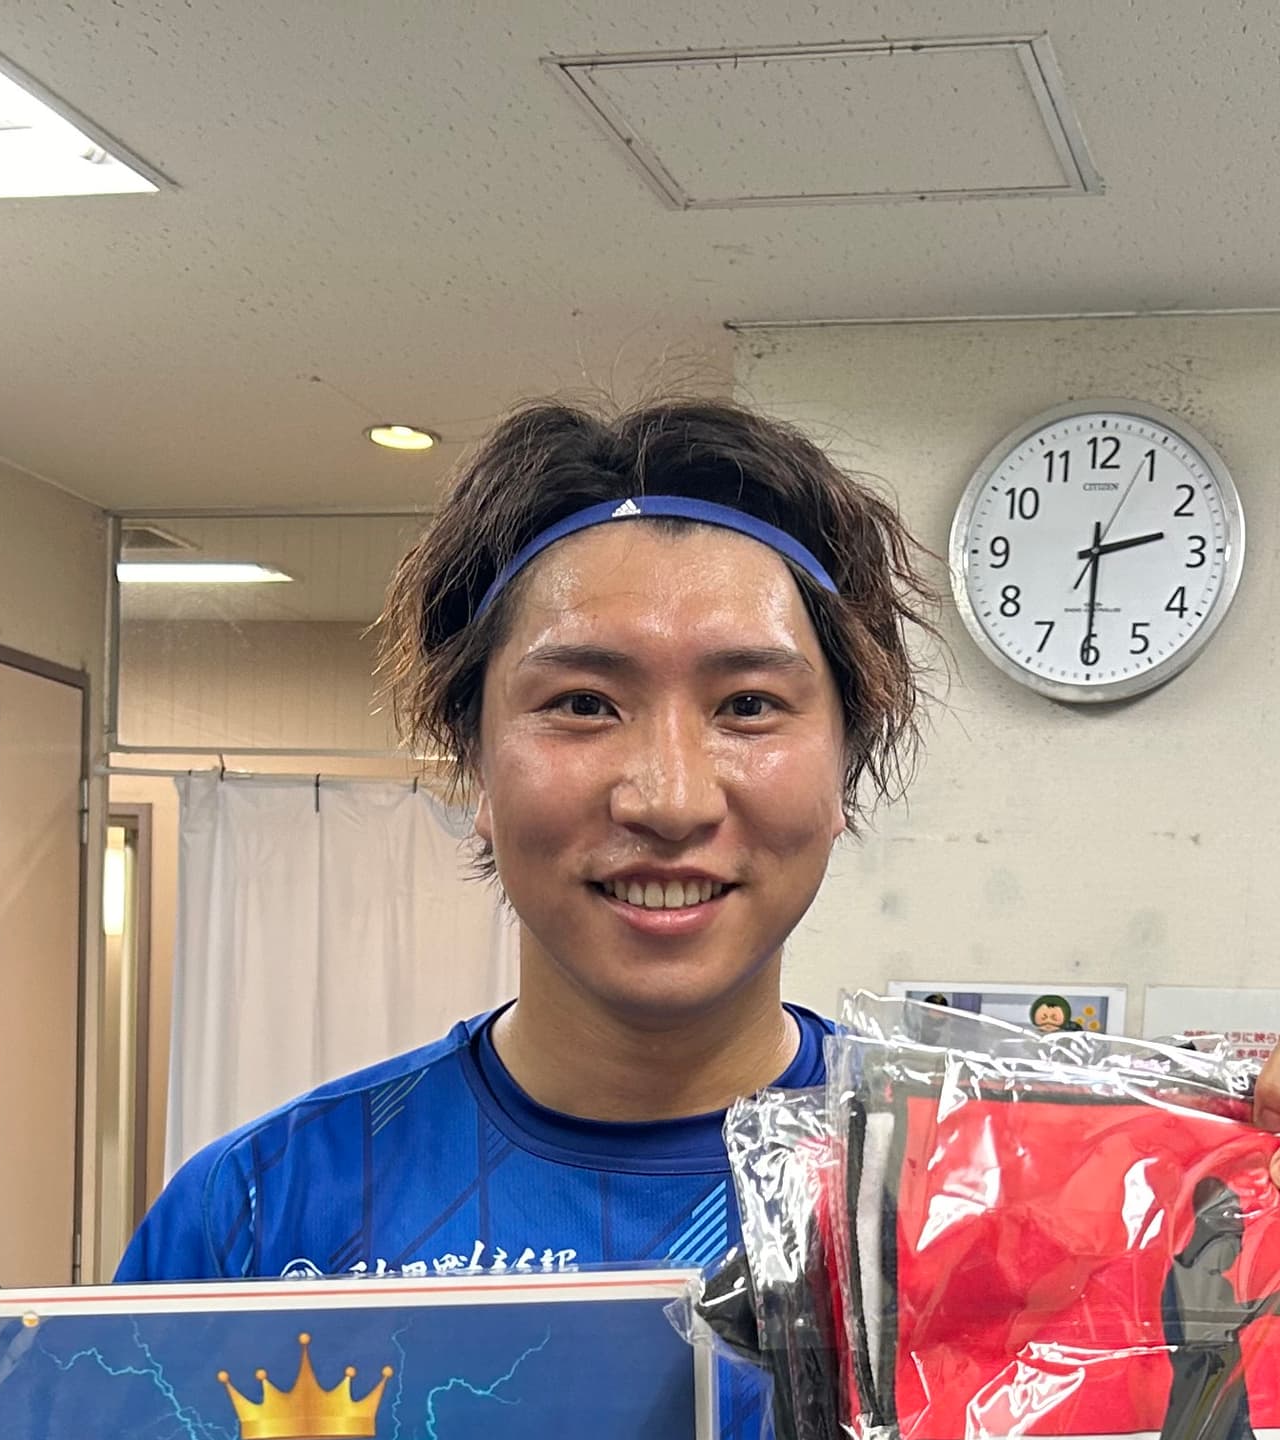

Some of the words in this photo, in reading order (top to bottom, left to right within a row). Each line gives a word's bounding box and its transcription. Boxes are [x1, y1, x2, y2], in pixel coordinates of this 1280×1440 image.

[1042, 449, 1071, 483] 11
[1086, 436, 1121, 470] 12
[1143, 448, 1156, 482] 1
[1004, 487, 1040, 520] 10
[1082, 482, 1120, 492] CITIZEN
[1173, 483, 1196, 518] 2
[989, 535, 1011, 569] 9
[1184, 534, 1207, 569] 3
[999, 584, 1021, 618] 8
[1163, 585, 1189, 619] 4
[1033, 620, 1056, 653] 7
[1079, 632, 1101, 667] 6
[1129, 621, 1151, 655] 5
